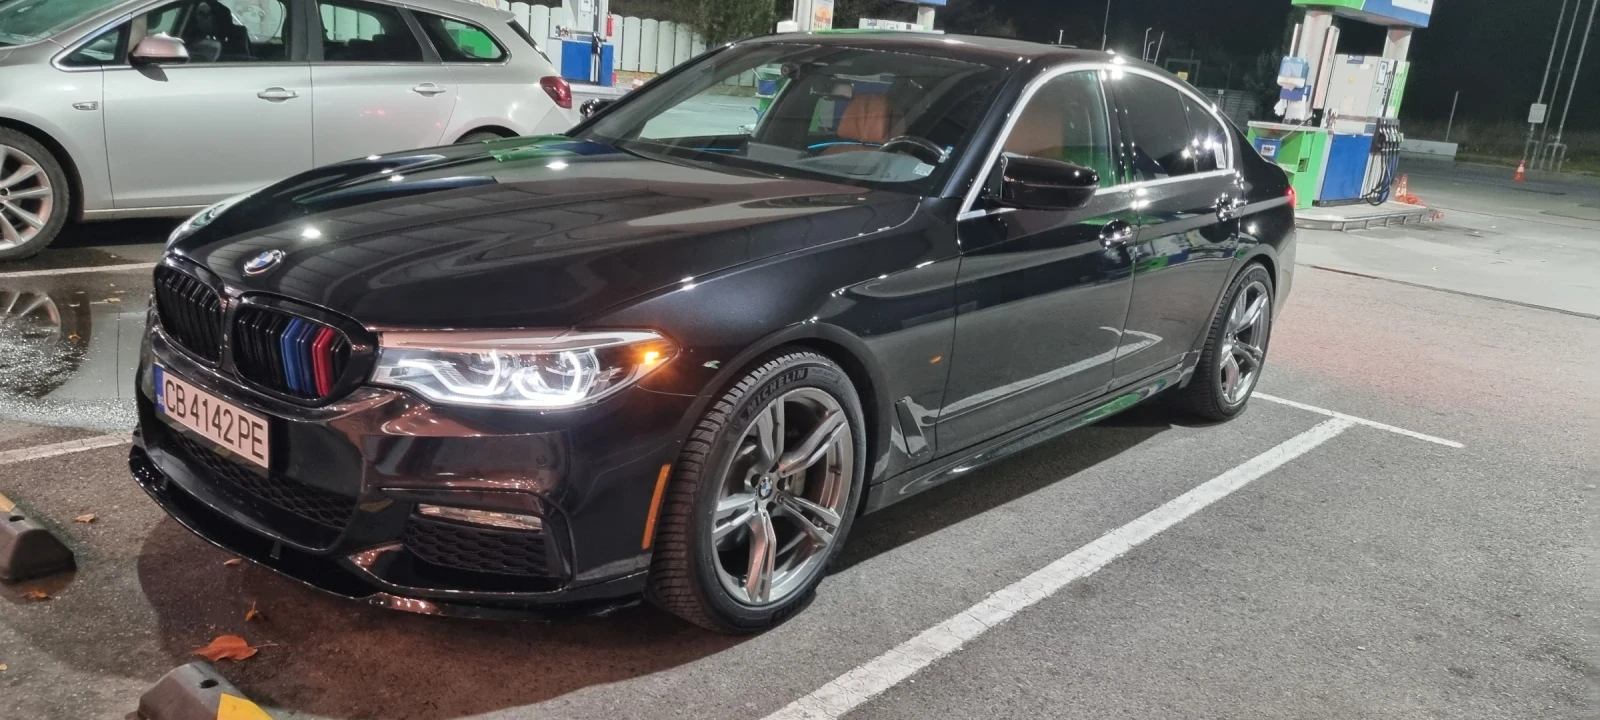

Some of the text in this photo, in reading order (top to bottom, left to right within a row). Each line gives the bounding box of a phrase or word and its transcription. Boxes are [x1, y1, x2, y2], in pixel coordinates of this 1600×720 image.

[165, 379, 264, 460] CB 4142 PE
[747, 368, 806, 416] MICHELIN
